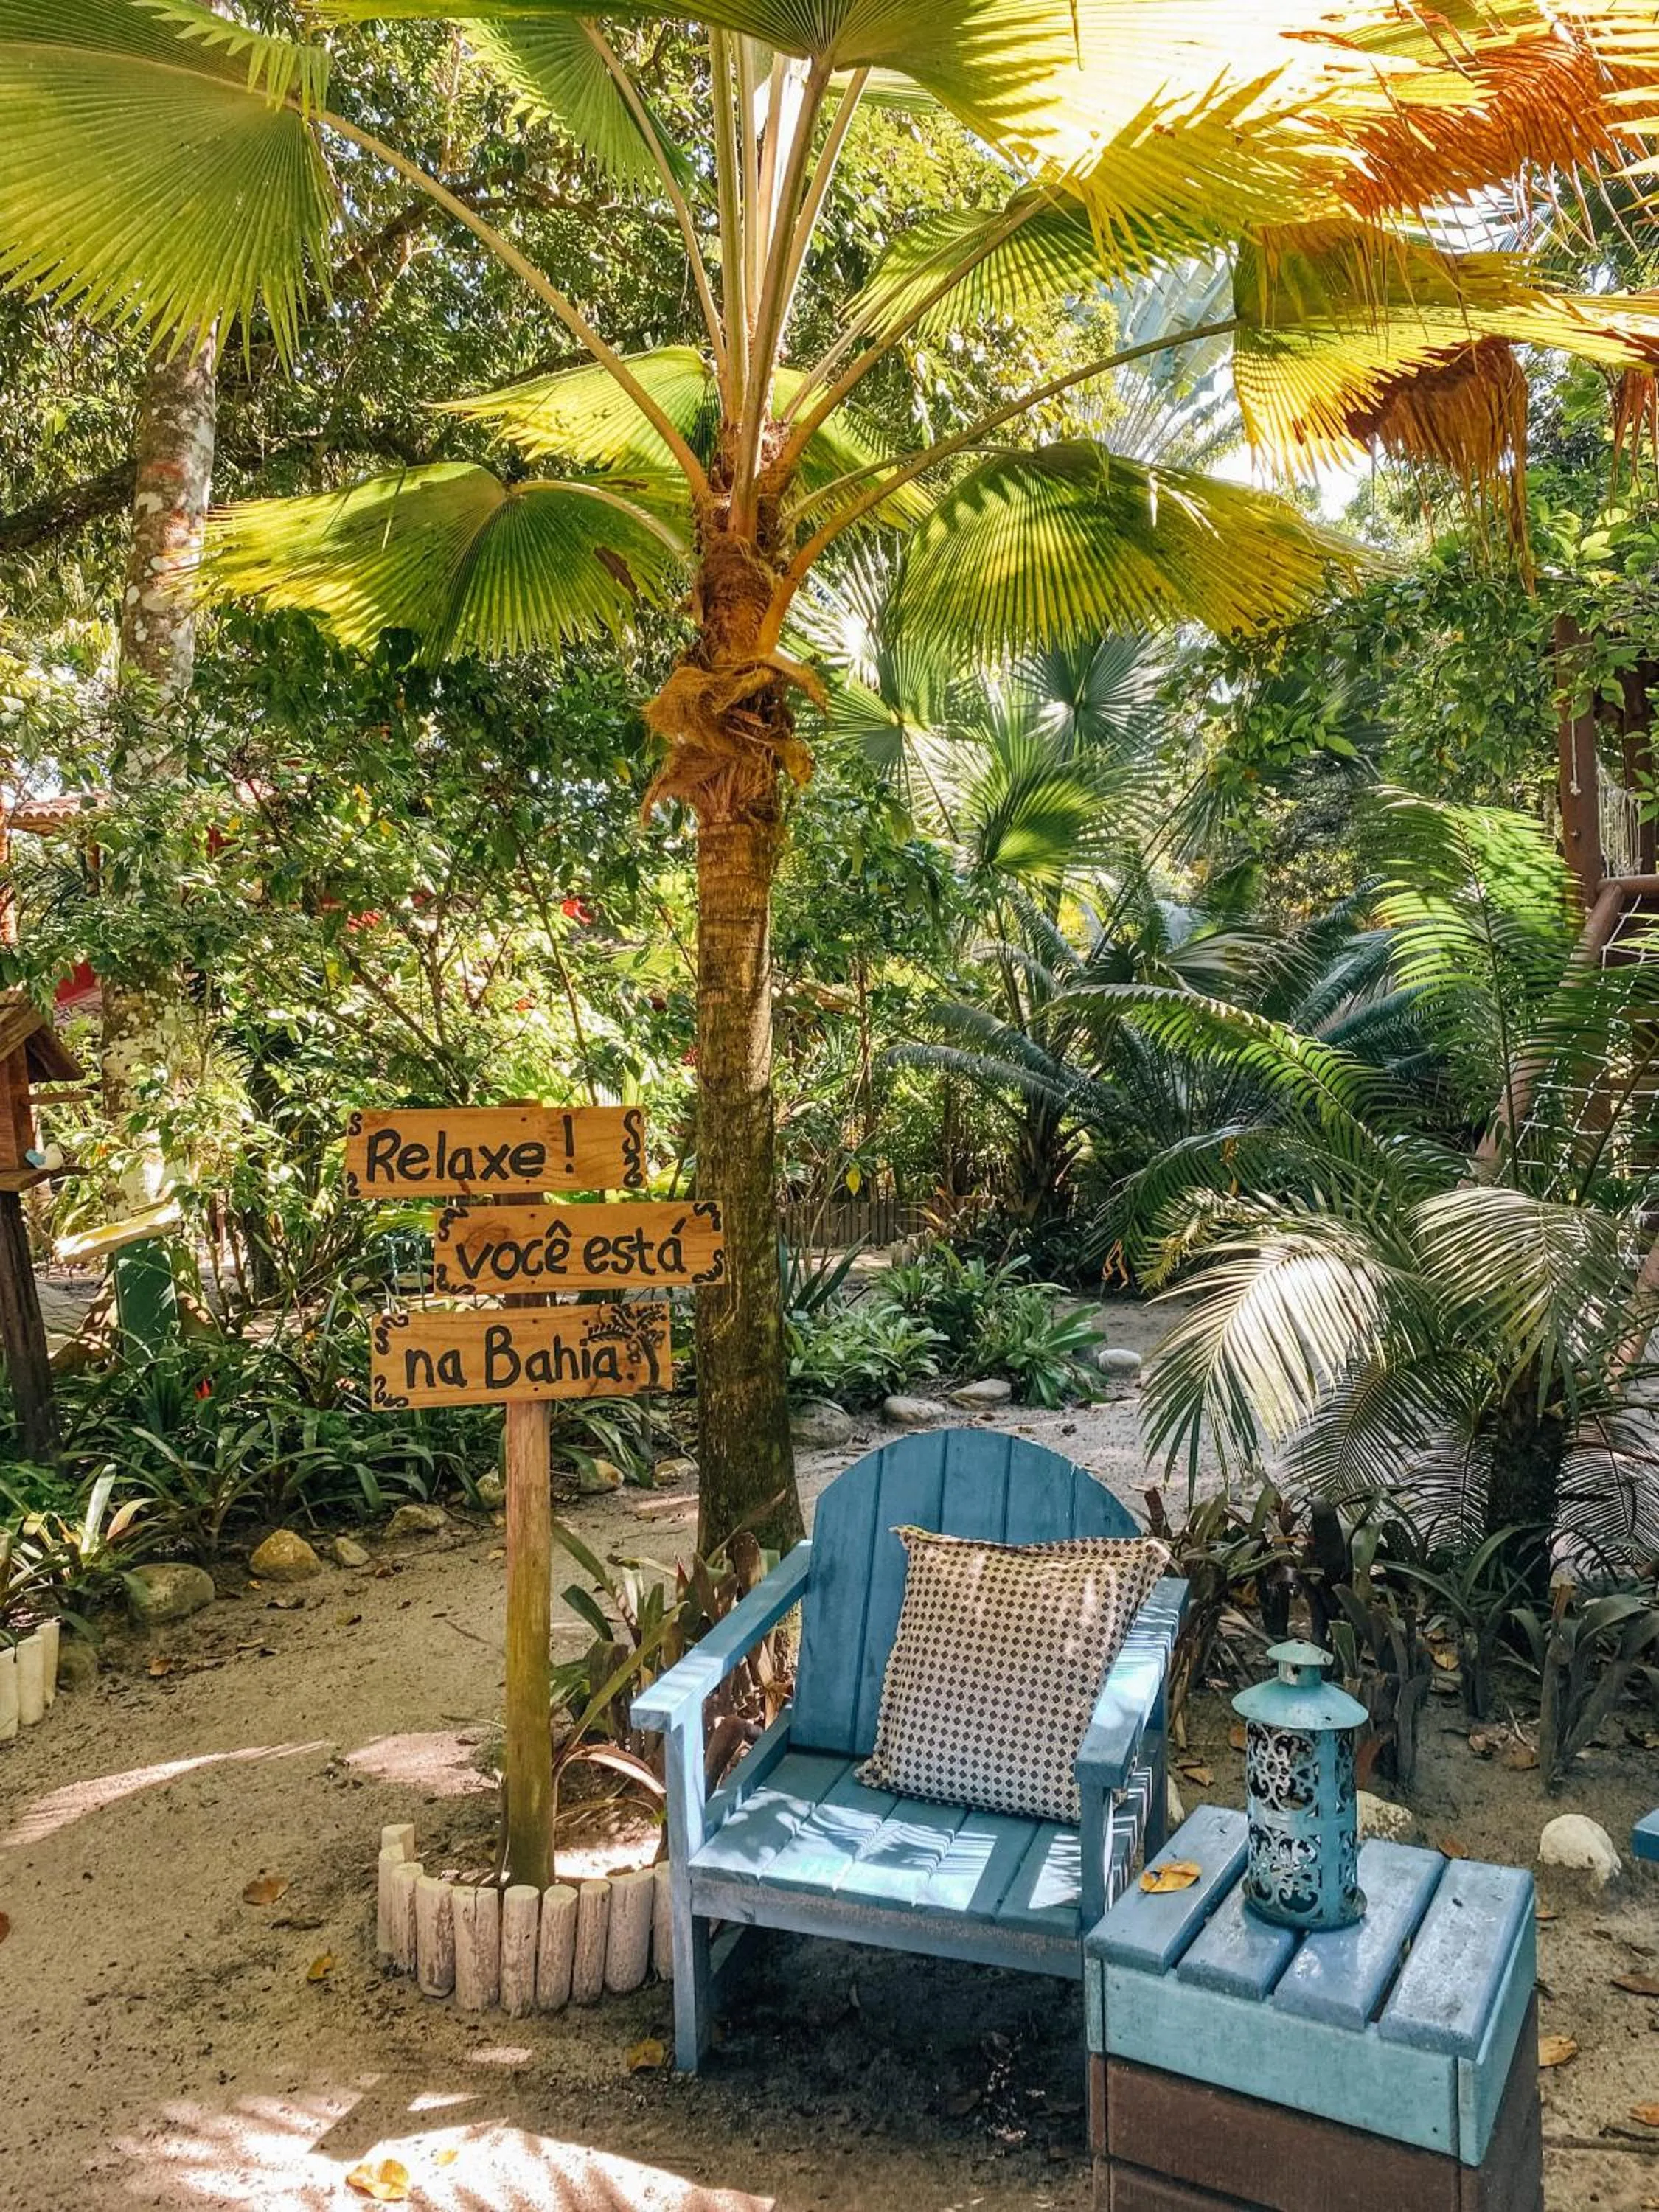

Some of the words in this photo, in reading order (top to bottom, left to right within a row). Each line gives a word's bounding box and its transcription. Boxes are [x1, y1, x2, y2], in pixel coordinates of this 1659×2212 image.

[456, 1219, 572, 1280] você
[583, 1217, 688, 1275] está
[404, 1348, 467, 1389] na
